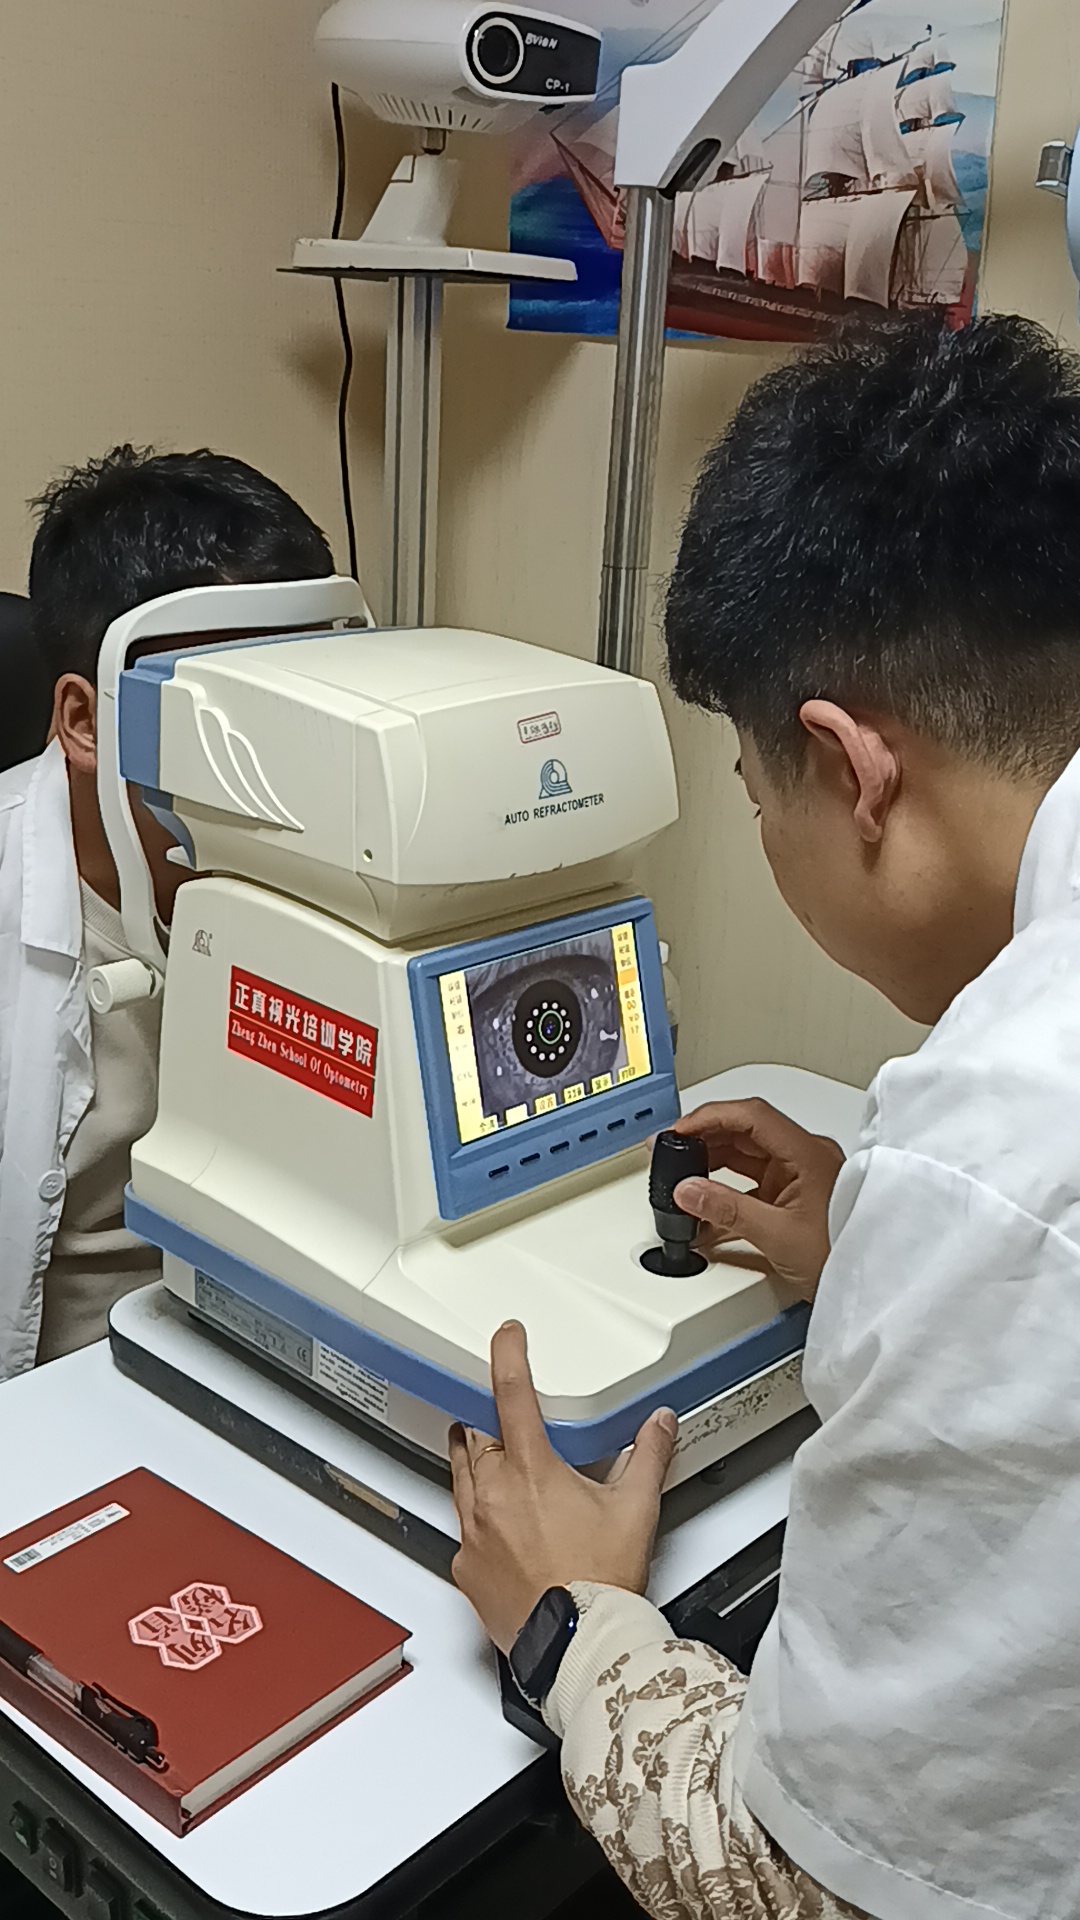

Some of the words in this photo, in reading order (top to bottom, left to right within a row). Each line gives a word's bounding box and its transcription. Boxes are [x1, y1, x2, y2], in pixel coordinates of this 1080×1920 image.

[504, 809, 530, 826] AUTO
[533, 793, 605, 820] REFRACTOMETER
[231, 1019, 256, 1046] Zheng
[257, 1031, 277, 1054] Zhen
[279, 1041, 308, 1069] School
[309, 1056, 321, 1075] Of
[323, 1062, 370, 1101] Optometry
